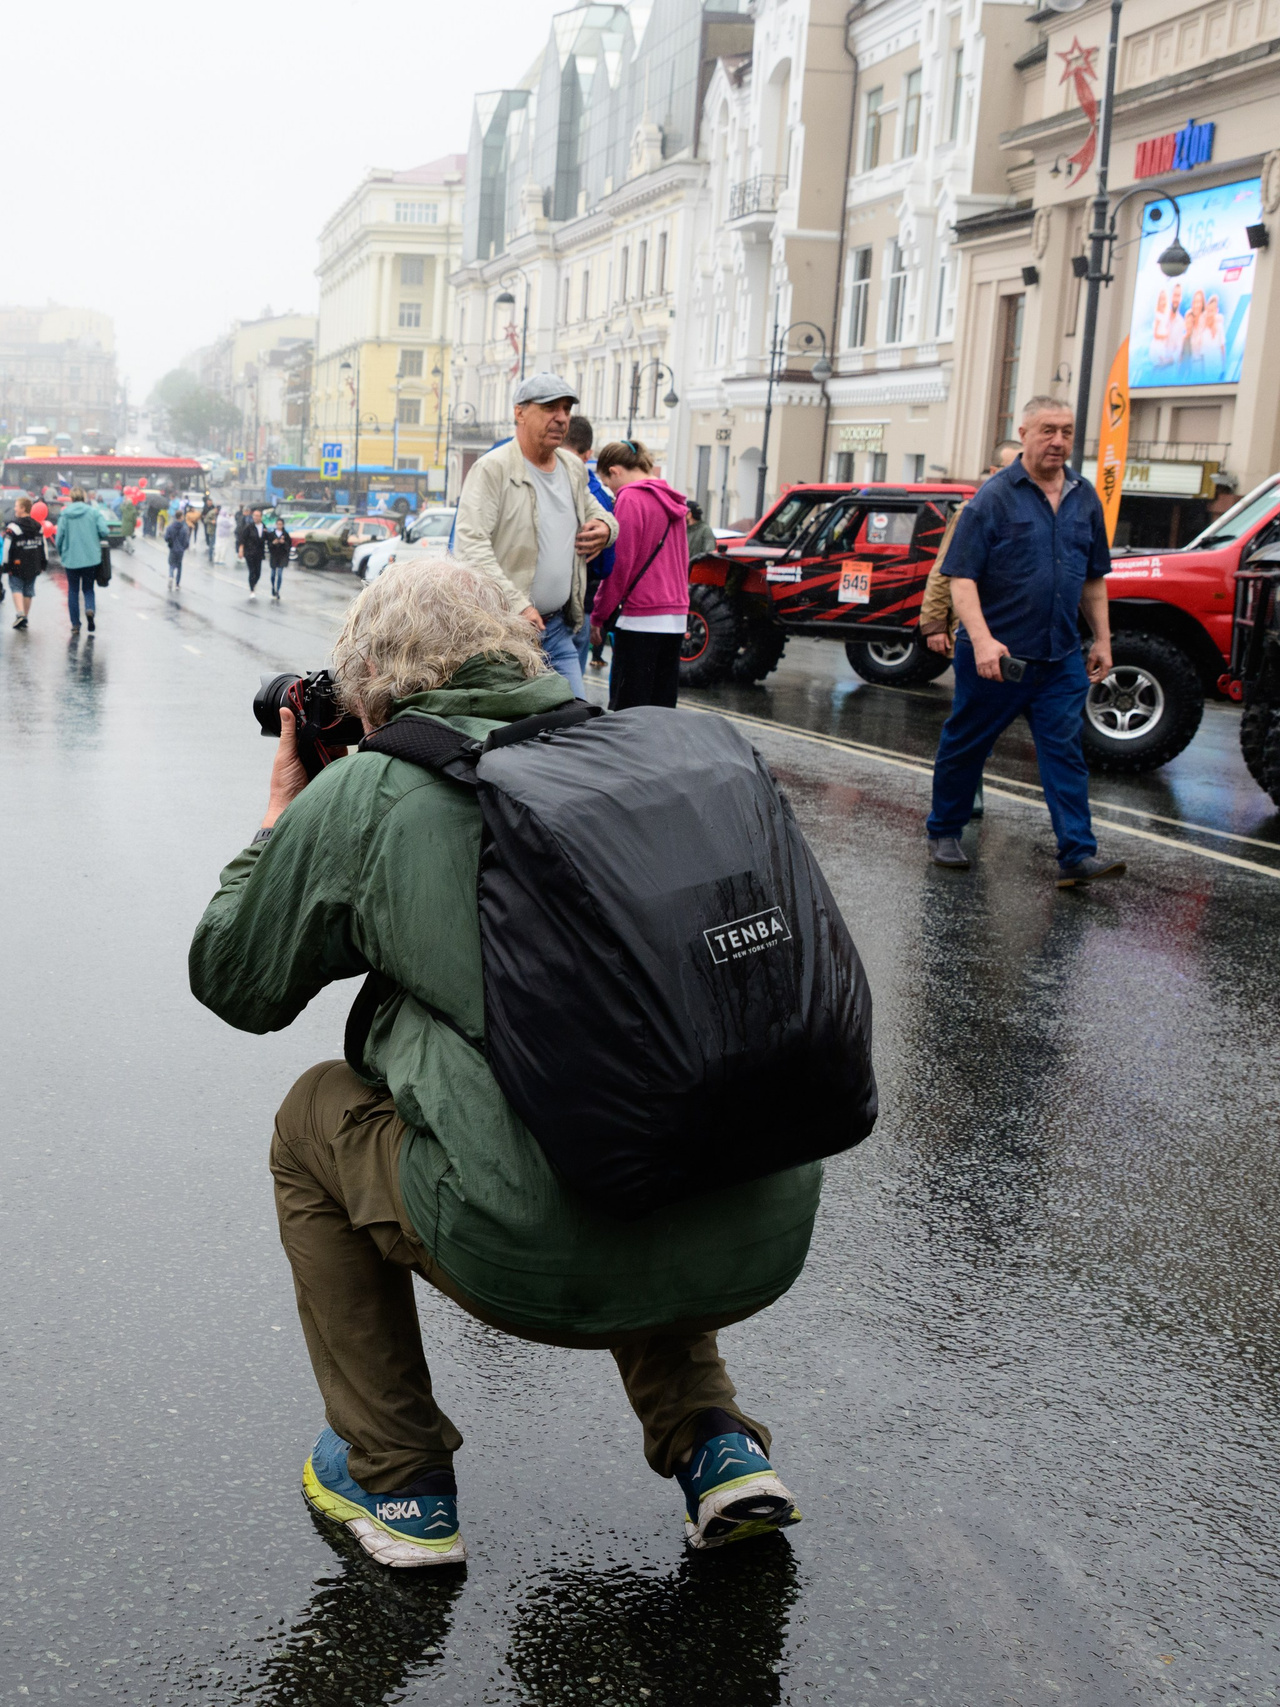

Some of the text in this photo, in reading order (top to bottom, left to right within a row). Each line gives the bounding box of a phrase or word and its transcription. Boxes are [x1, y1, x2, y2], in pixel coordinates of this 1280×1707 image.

[842, 573, 869, 591] 545
[714, 917, 783, 952] TENBA
[732, 939, 778, 960] NEW YORK 1977
[376, 1500, 422, 1520] HOKA
